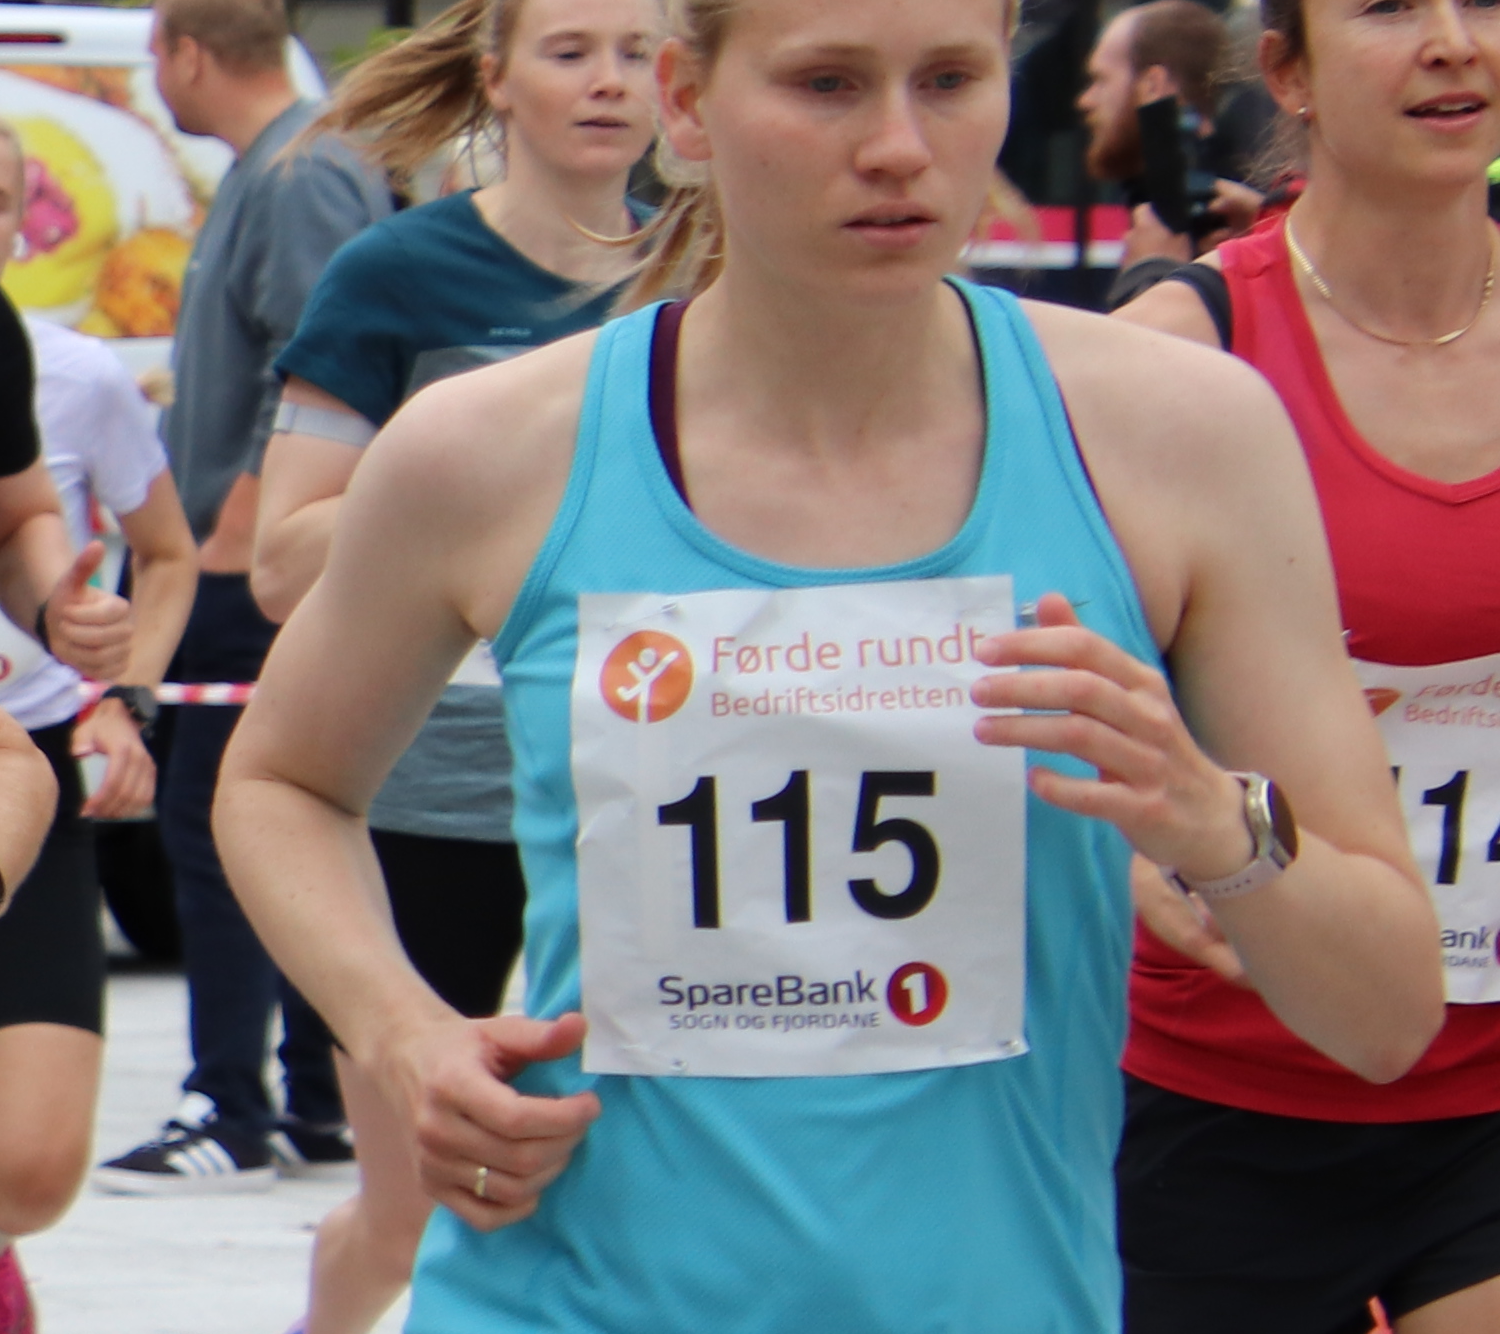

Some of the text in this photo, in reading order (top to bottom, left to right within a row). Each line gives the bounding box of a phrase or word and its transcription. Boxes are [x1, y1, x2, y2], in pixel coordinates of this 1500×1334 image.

[711, 623, 986, 674] Førde rundt
[710, 684, 964, 717] Bedriftsidretten
[657, 769, 942, 929] 115
[658, 969, 877, 1011] SpareBank
[669, 1012, 881, 1033] SOGN OG FJORDANE
